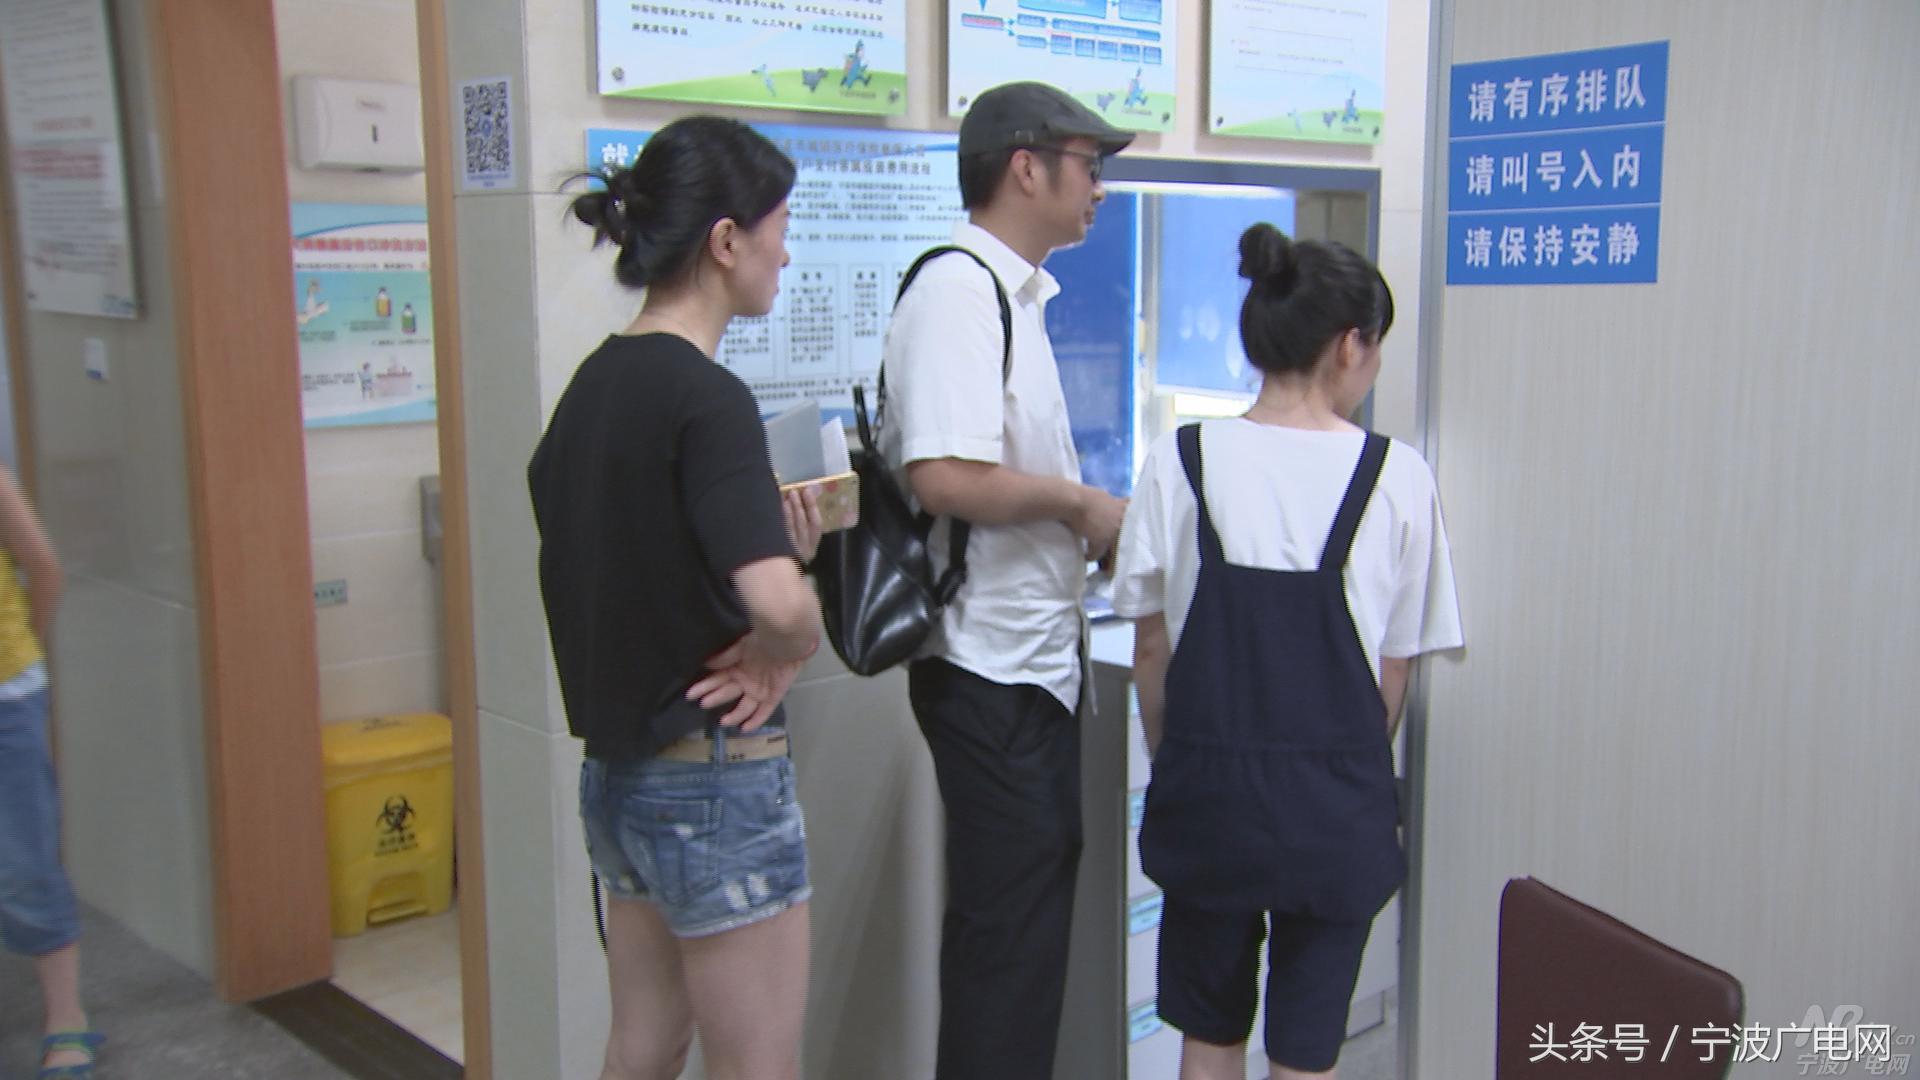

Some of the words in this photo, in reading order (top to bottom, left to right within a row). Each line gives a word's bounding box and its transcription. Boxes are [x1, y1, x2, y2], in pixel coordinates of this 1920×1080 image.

[1468, 64, 1647, 123] 请有序排队
[1466, 144, 1641, 196] 请叫号入内
[1464, 221, 1640, 268] 请保持安静
